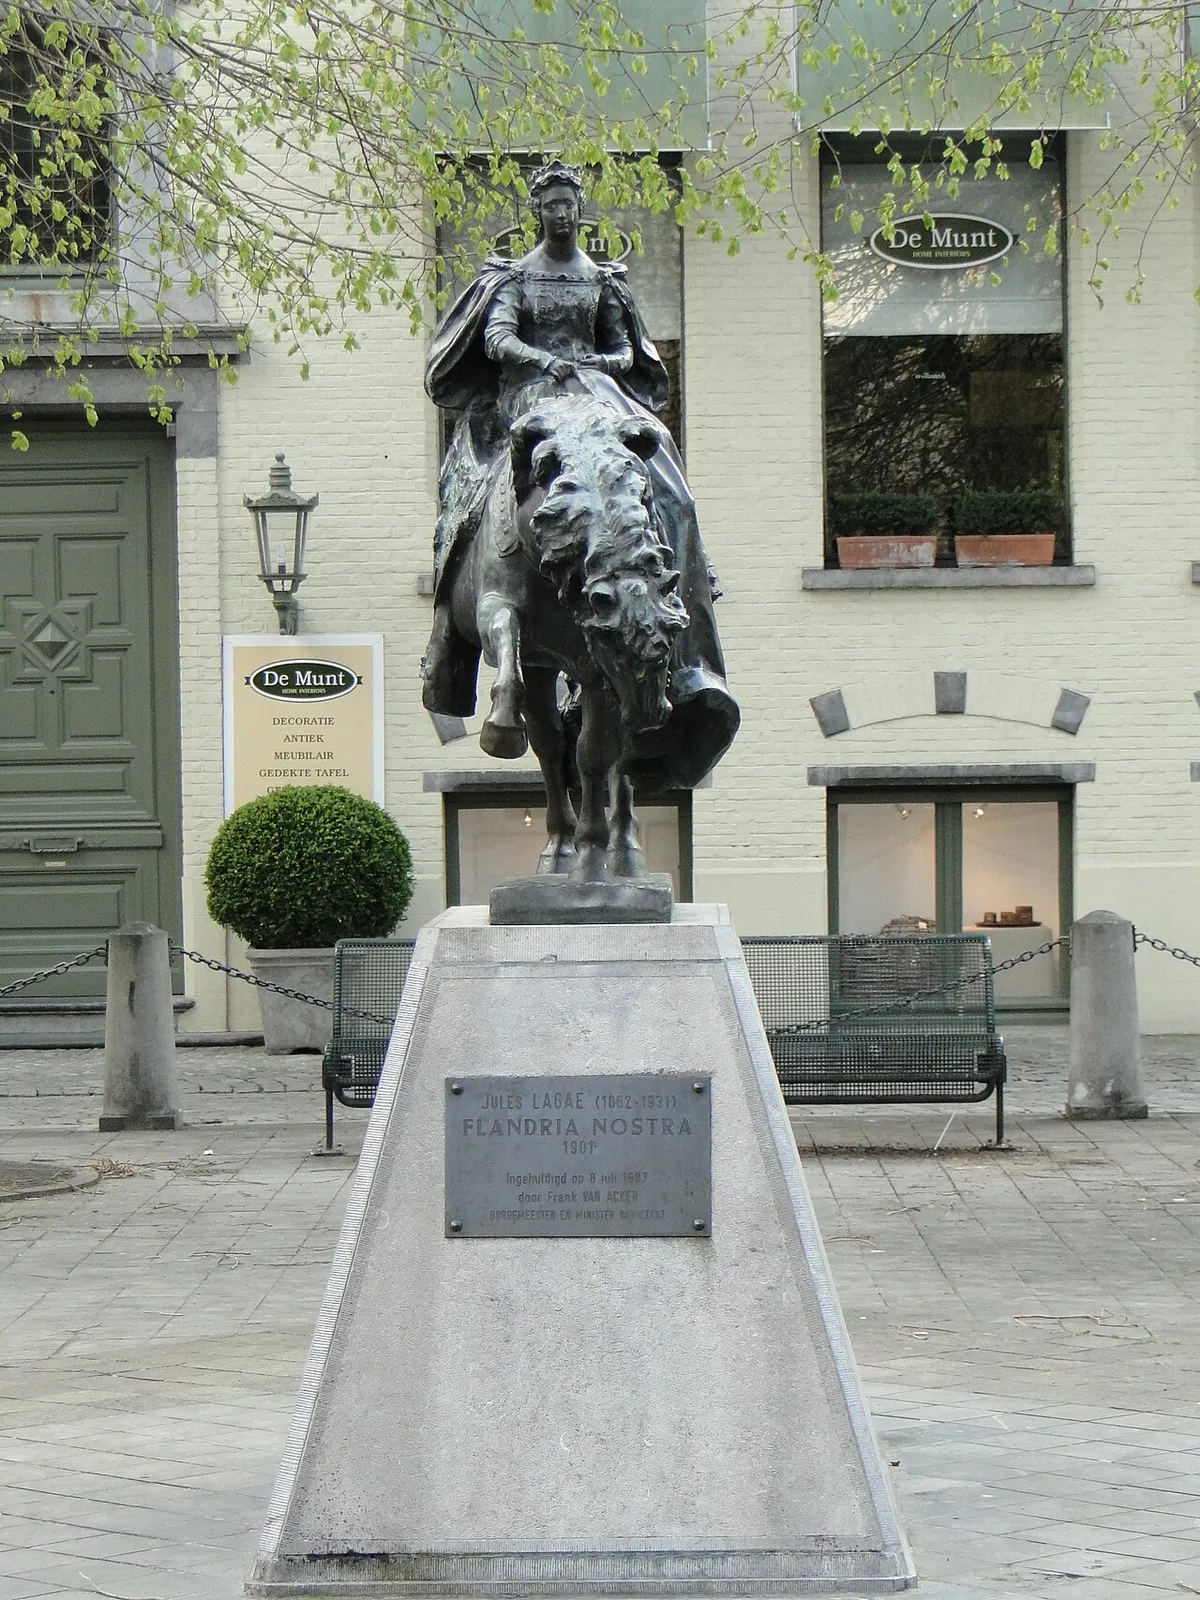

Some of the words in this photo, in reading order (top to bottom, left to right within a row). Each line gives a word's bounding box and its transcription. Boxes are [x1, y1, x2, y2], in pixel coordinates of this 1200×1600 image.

[888, 229, 922, 248] De
[931, 228, 998, 248] Munt
[912, 250, 932, 258] HOME
[263, 671, 289, 686] De
[295, 671, 346, 686] Munt
[272, 717, 335, 726] DECORATIE
[283, 734, 324, 743] ANTIEK
[274, 752, 334, 760] MEUBILAIR
[259, 769, 312, 777] GEDEKTE
[315, 769, 349, 777] TAFEL
[481, 1094, 523, 1110] JULES
[533, 1092, 584, 1109] LAGAE
[463, 1118, 579, 1136] FLANDRIA
[593, 1118, 692, 1136] NOSTRA
[563, 1141, 595, 1155] 1901
[506, 1172, 567, 1186] Ingehuldigd
[572, 1175, 584, 1186] op
[622, 1172, 648, 1183] 1987
[518, 1191, 541, 1202] door
[547, 1191, 578, 1202] Frank
[583, 1190, 601, 1201] VAN
